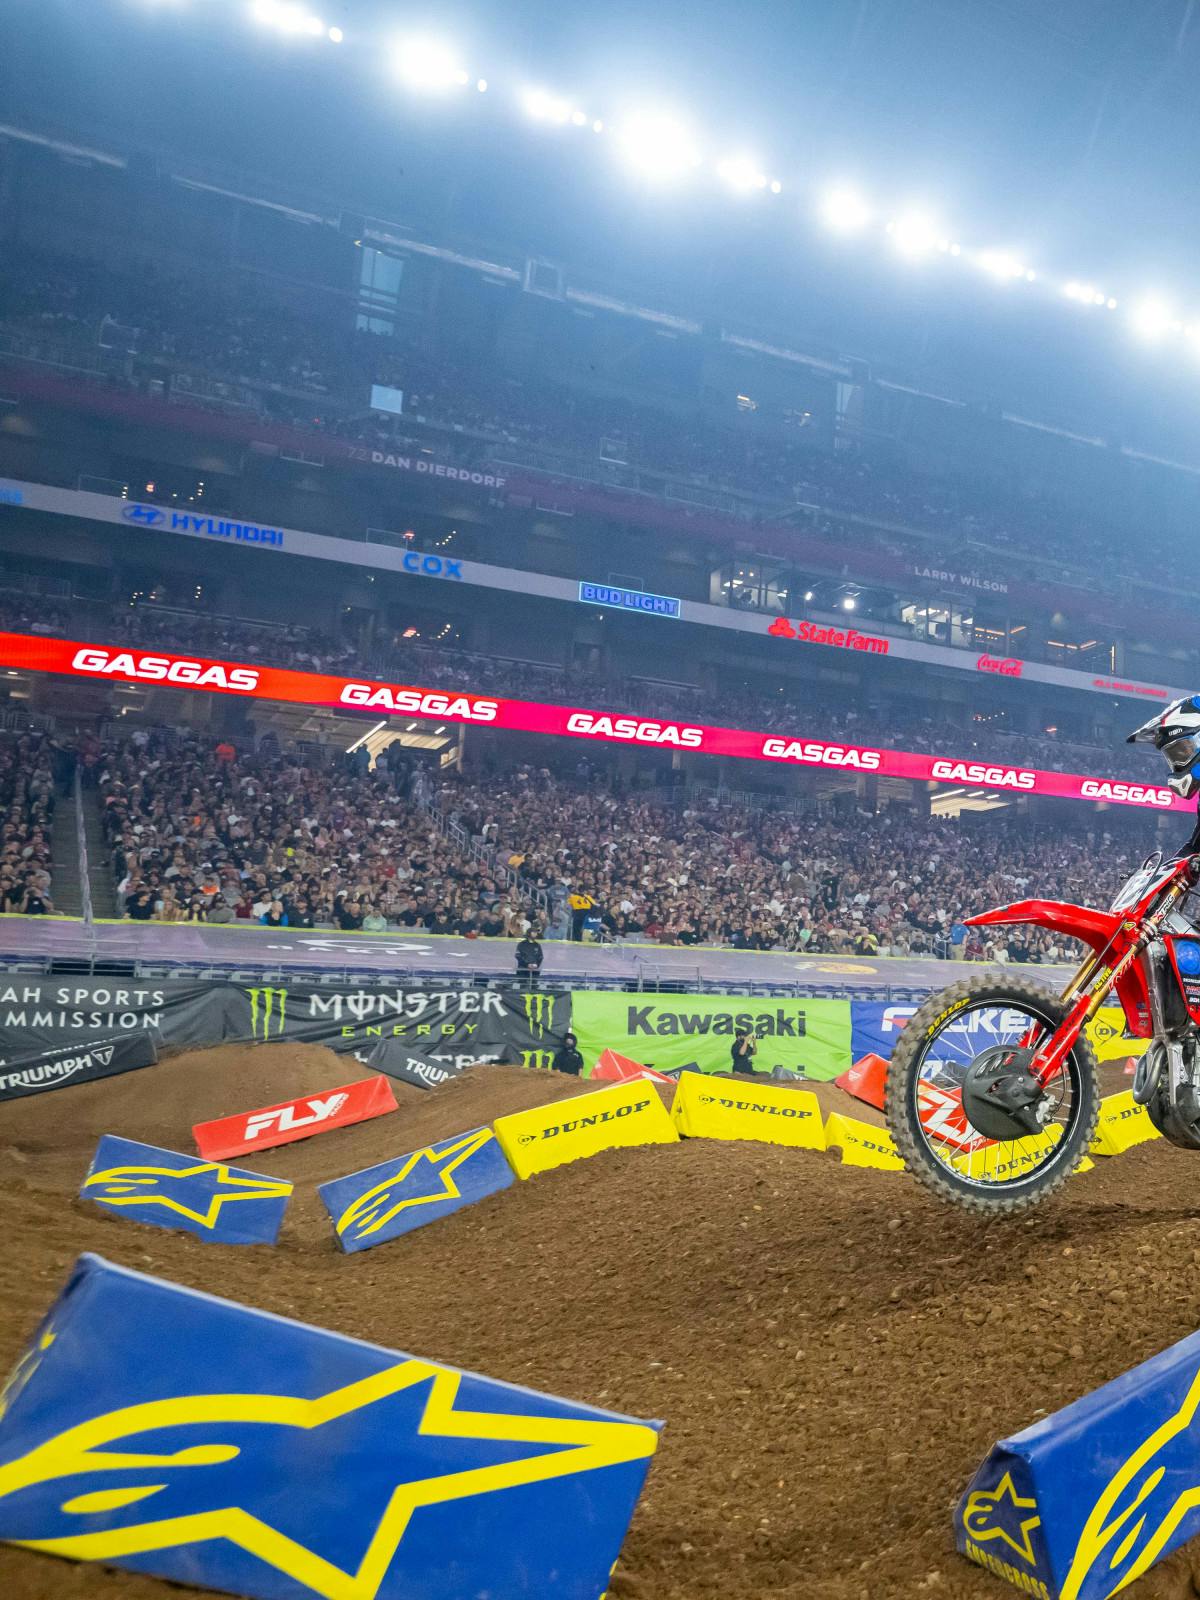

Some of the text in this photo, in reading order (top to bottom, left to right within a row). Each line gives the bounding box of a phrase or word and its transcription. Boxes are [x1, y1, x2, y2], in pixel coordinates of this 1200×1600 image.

[371, 452, 411, 469] DAN
[416, 461, 506, 488] DIERDORF
[171, 513, 285, 545] HYUNDAI
[403, 552, 463, 580] COX
[914, 566, 1008, 593] LARRY WILSON
[583, 585, 678, 614] BUD LIGHT
[797, 620, 890, 655] State Farm
[73, 650, 259, 690] GASGAS
[340, 683, 498, 721] GASGAS
[567, 713, 703, 747] GASGAS
[762, 738, 881, 769] GASGAS
[930, 761, 1036, 789] GASGAS
[1081, 779, 1173, 805] GASGAS
[0, 987, 165, 1006] AH SPORTS
[309, 990, 508, 1021] MONSTER
[5, 1011, 160, 1029] MMISSION
[341, 1023, 478, 1037] ENERGY
[628, 1006, 807, 1037] Kawasaki
[244, 1092, 349, 1140] FLY
[541, 1100, 651, 1140] DUNLOP
[718, 1099, 812, 1119] DUNLOP
